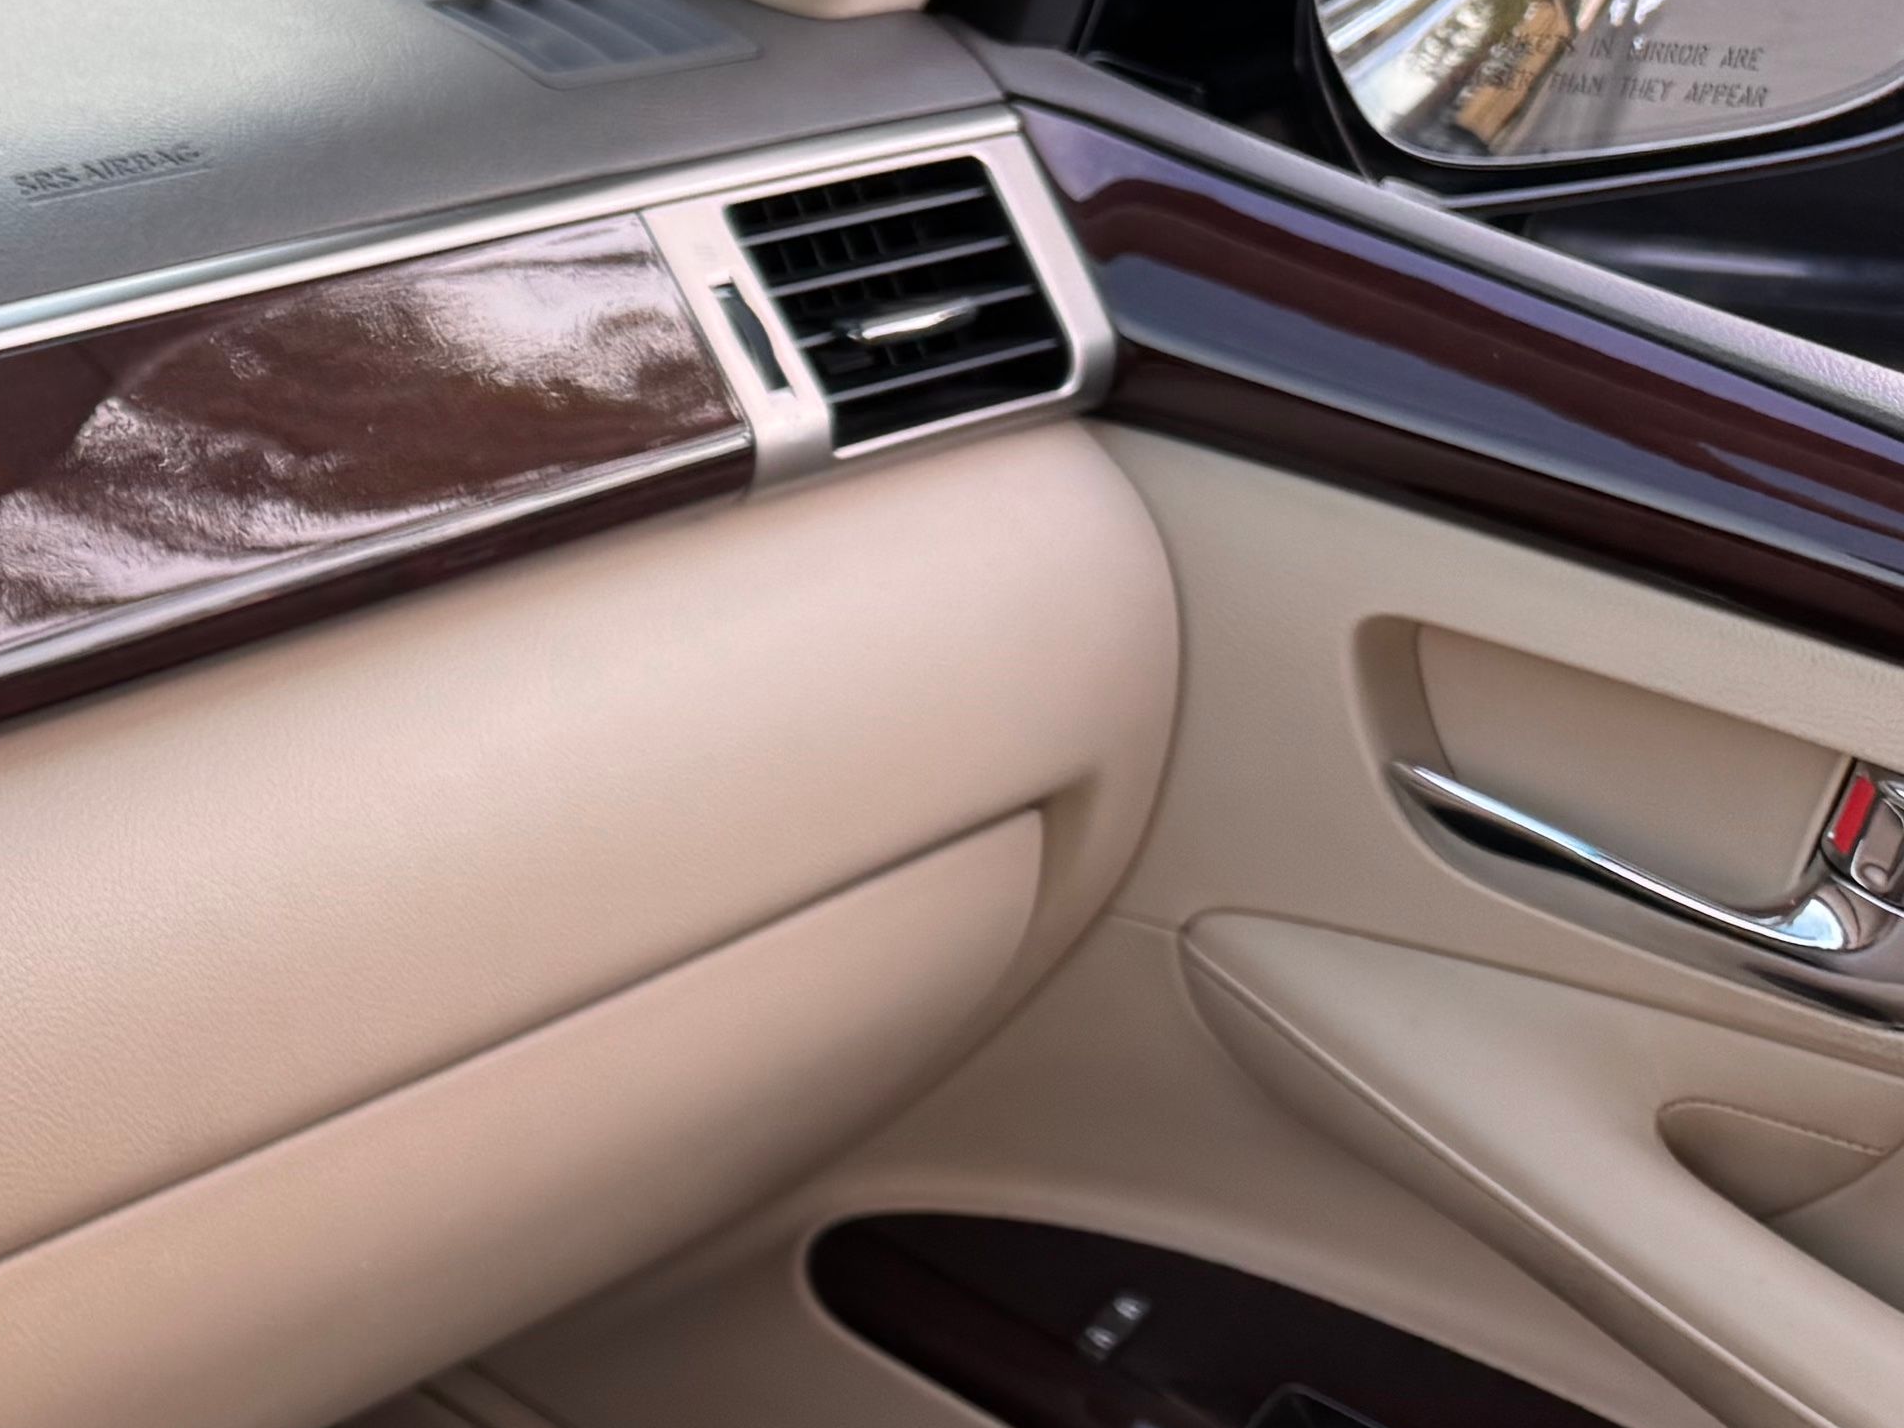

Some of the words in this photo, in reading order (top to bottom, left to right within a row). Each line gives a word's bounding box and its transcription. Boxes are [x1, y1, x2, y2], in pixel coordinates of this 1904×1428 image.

[1588, 36, 1613, 63] IN
[1720, 46, 1765, 72] ARE
[1550, 74, 1603, 98] THAN
[1619, 76, 1671, 103] THEY
[1685, 82, 1772, 109] APPEAR
